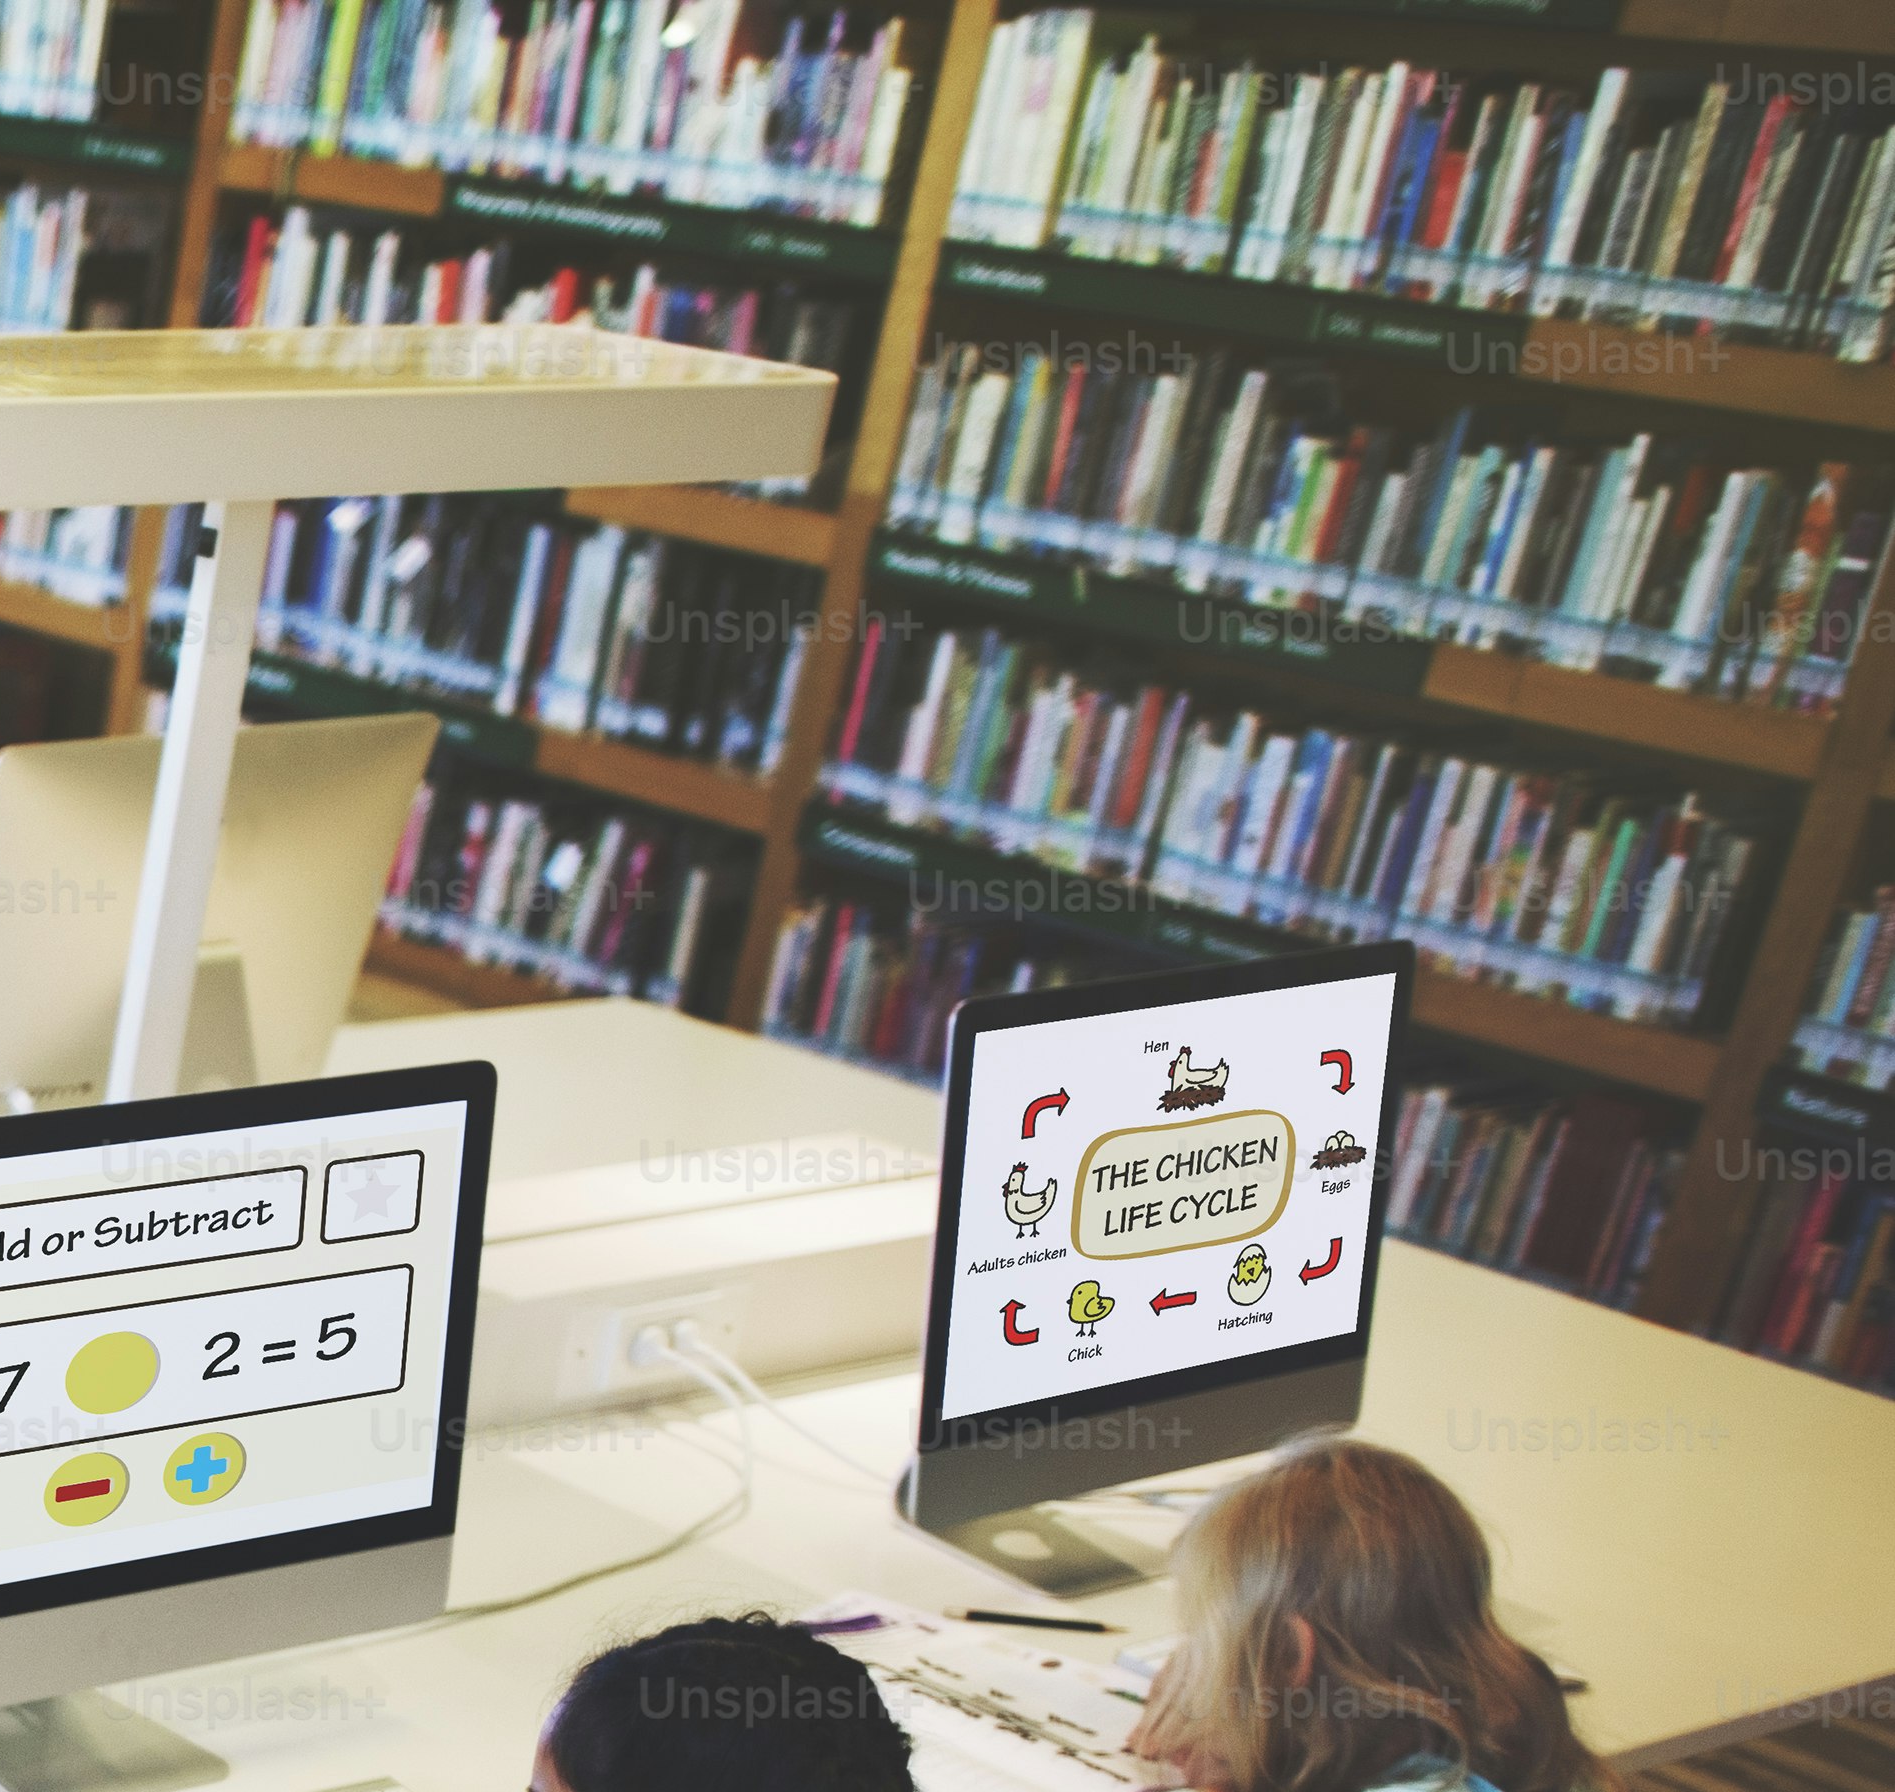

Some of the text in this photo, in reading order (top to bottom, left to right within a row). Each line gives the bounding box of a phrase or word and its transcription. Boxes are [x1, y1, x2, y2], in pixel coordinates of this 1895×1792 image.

[1144, 1040, 1169, 1054] Hen
[1092, 1136, 1278, 1193] THE CHICKEN
[1321, 1178, 1351, 1194] Eggs
[1104, 1184, 1258, 1236] LIFE CYCLE
[42, 1229, 85, 1256] or
[94, 1200, 275, 1248] Subtract
[967, 1247, 1067, 1275] Adults chicken
[1217, 1311, 1273, 1331] Hatching
[202, 1331, 241, 1380] 2
[316, 1313, 357, 1361] 5
[1068, 1345, 1103, 1362] Chick
